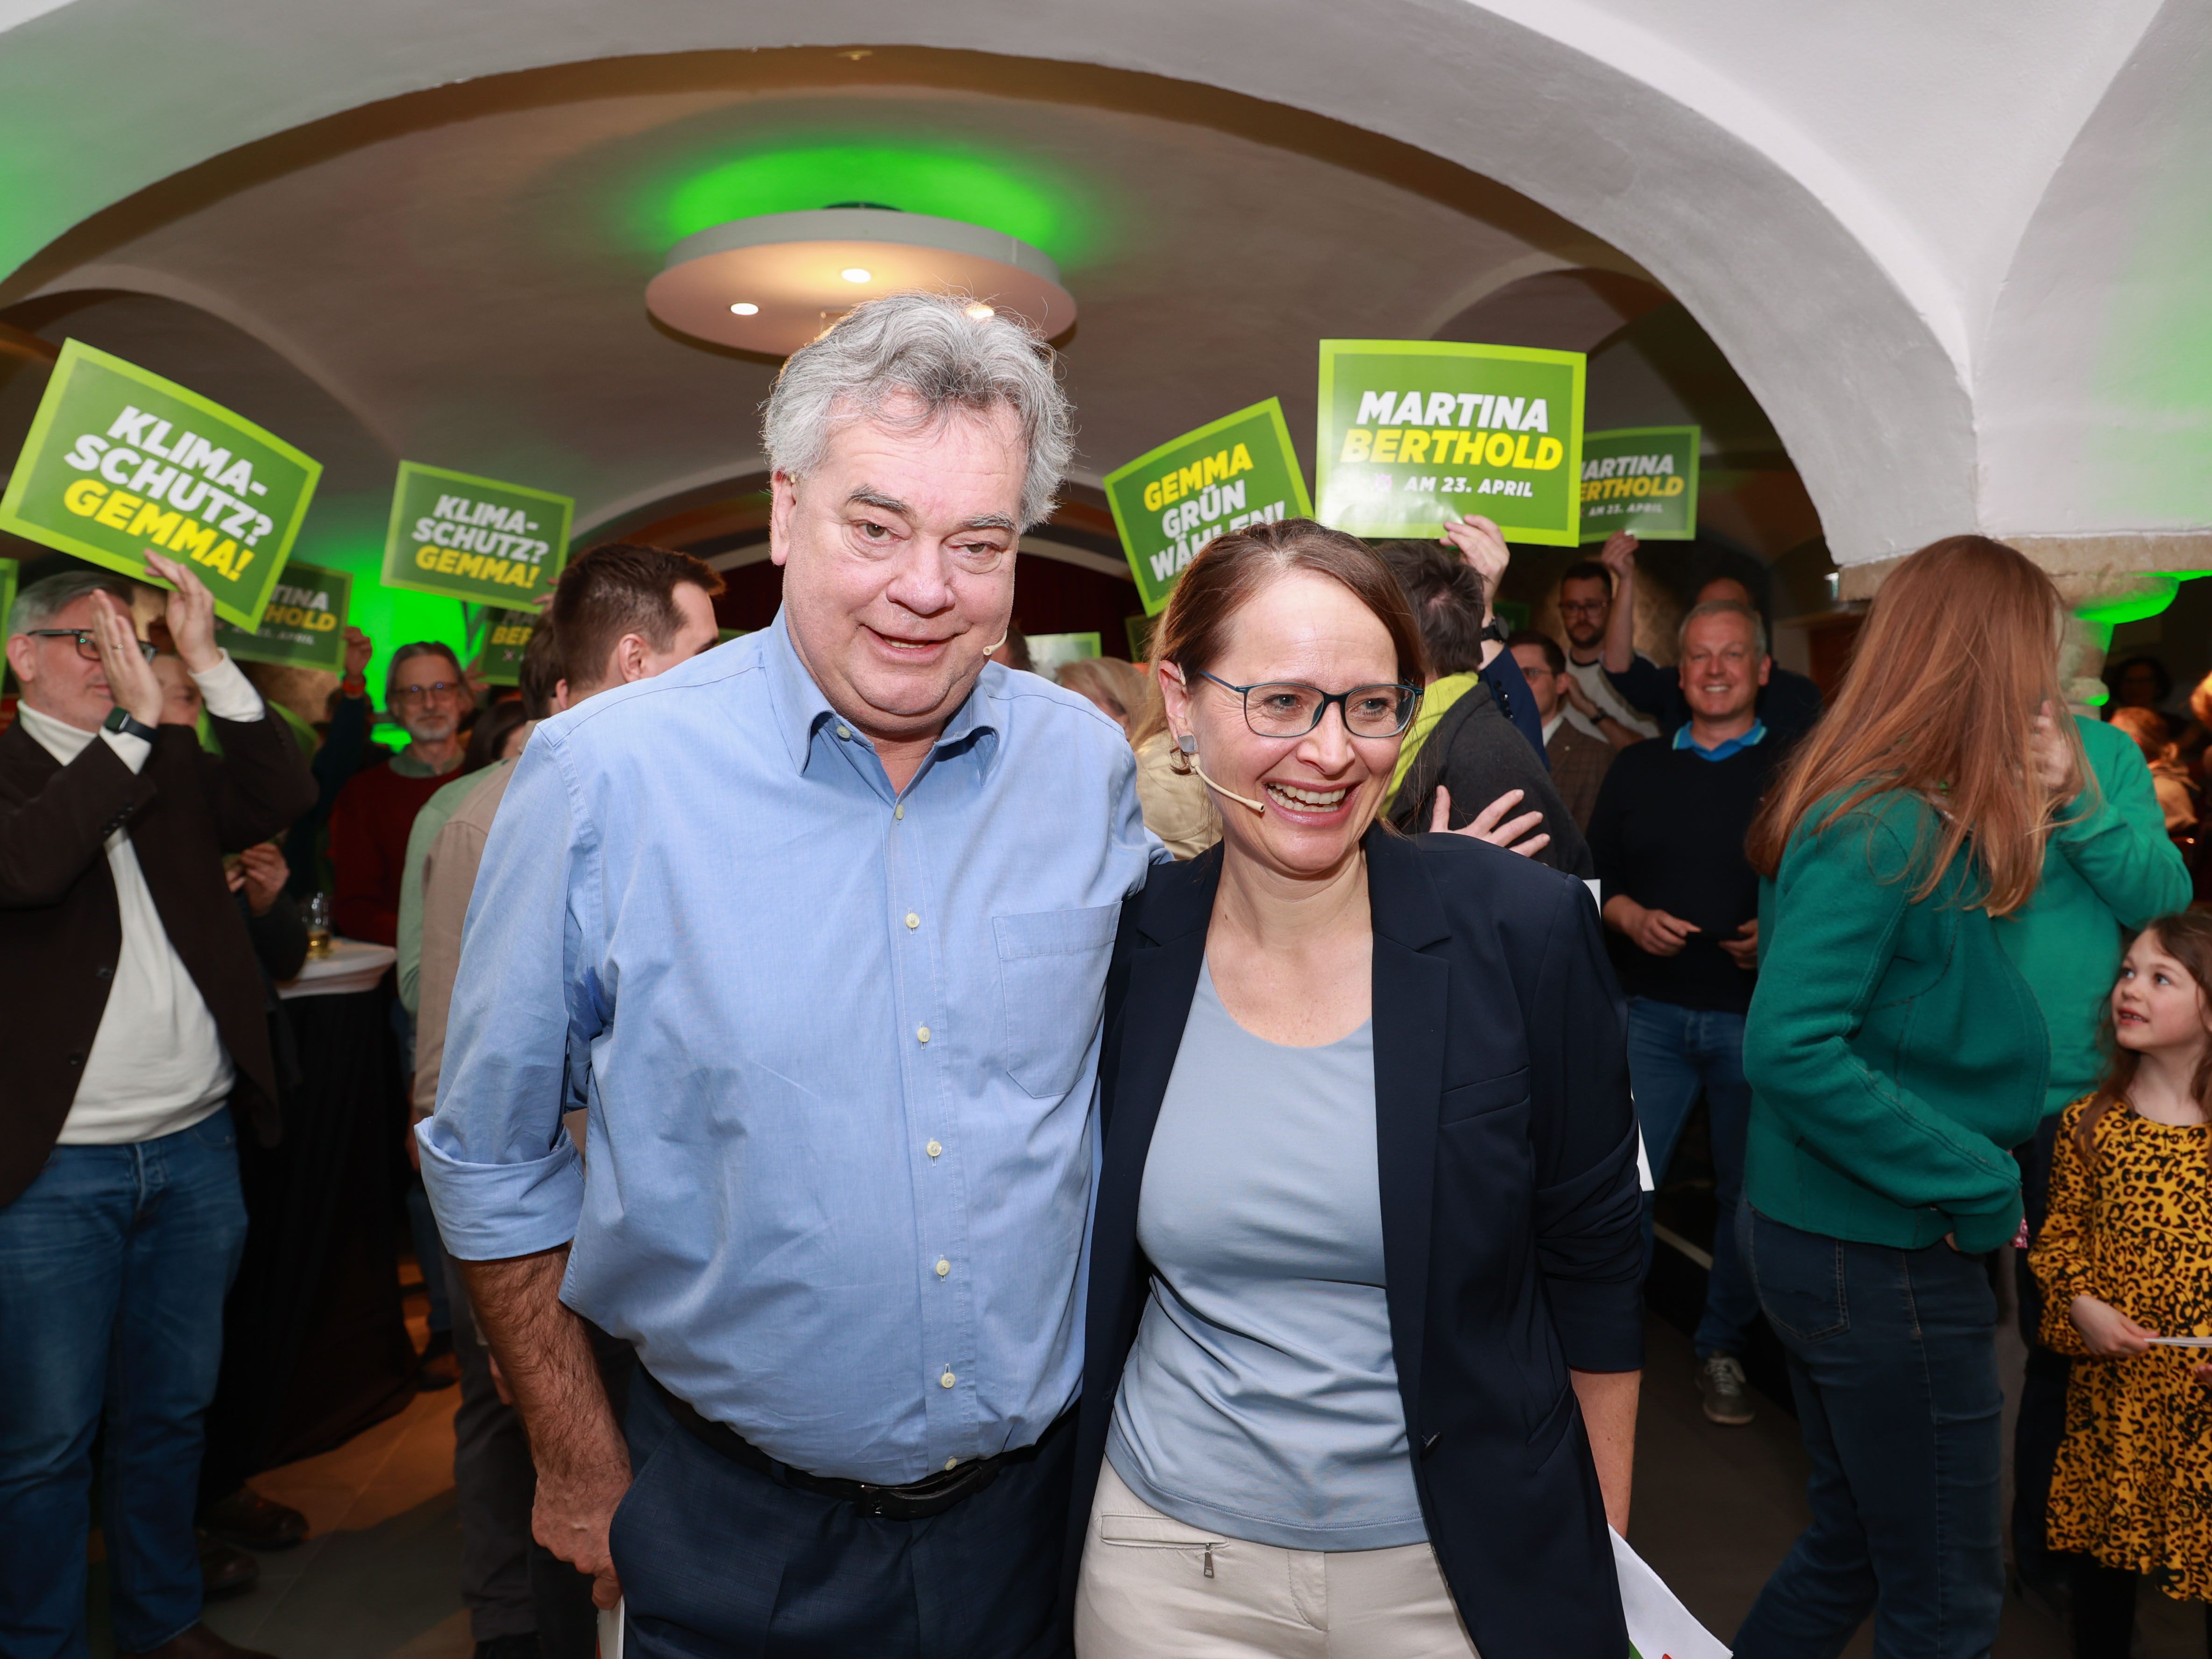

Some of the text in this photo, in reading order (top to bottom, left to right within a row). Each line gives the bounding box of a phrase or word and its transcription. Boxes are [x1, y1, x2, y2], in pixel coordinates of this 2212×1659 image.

[1356, 390, 1548, 433] MARTINA
[107, 405, 268, 496] KLIMA-
[1340, 428, 1563, 470] BERTHOLD
[1581, 454, 1674, 481] ARTINA
[64, 434, 273, 547] SCHUTZ?
[1144, 443, 1254, 511] GEMMA
[1404, 476, 1533, 497] AM 23. APRIL
[1581, 475, 1685, 502] ERTHOLD
[433, 495, 539, 534] KLIMA-
[1162, 480, 1246, 539] GRÜN
[1626, 503, 1663, 513] APRIL
[64, 479, 255, 582] GEMMA!
[412, 518, 549, 563] SCHUTZ?
[415, 546, 540, 588] GEMMA!
[264, 604, 337, 631] HOLD
[270, 584, 329, 611] TINA
